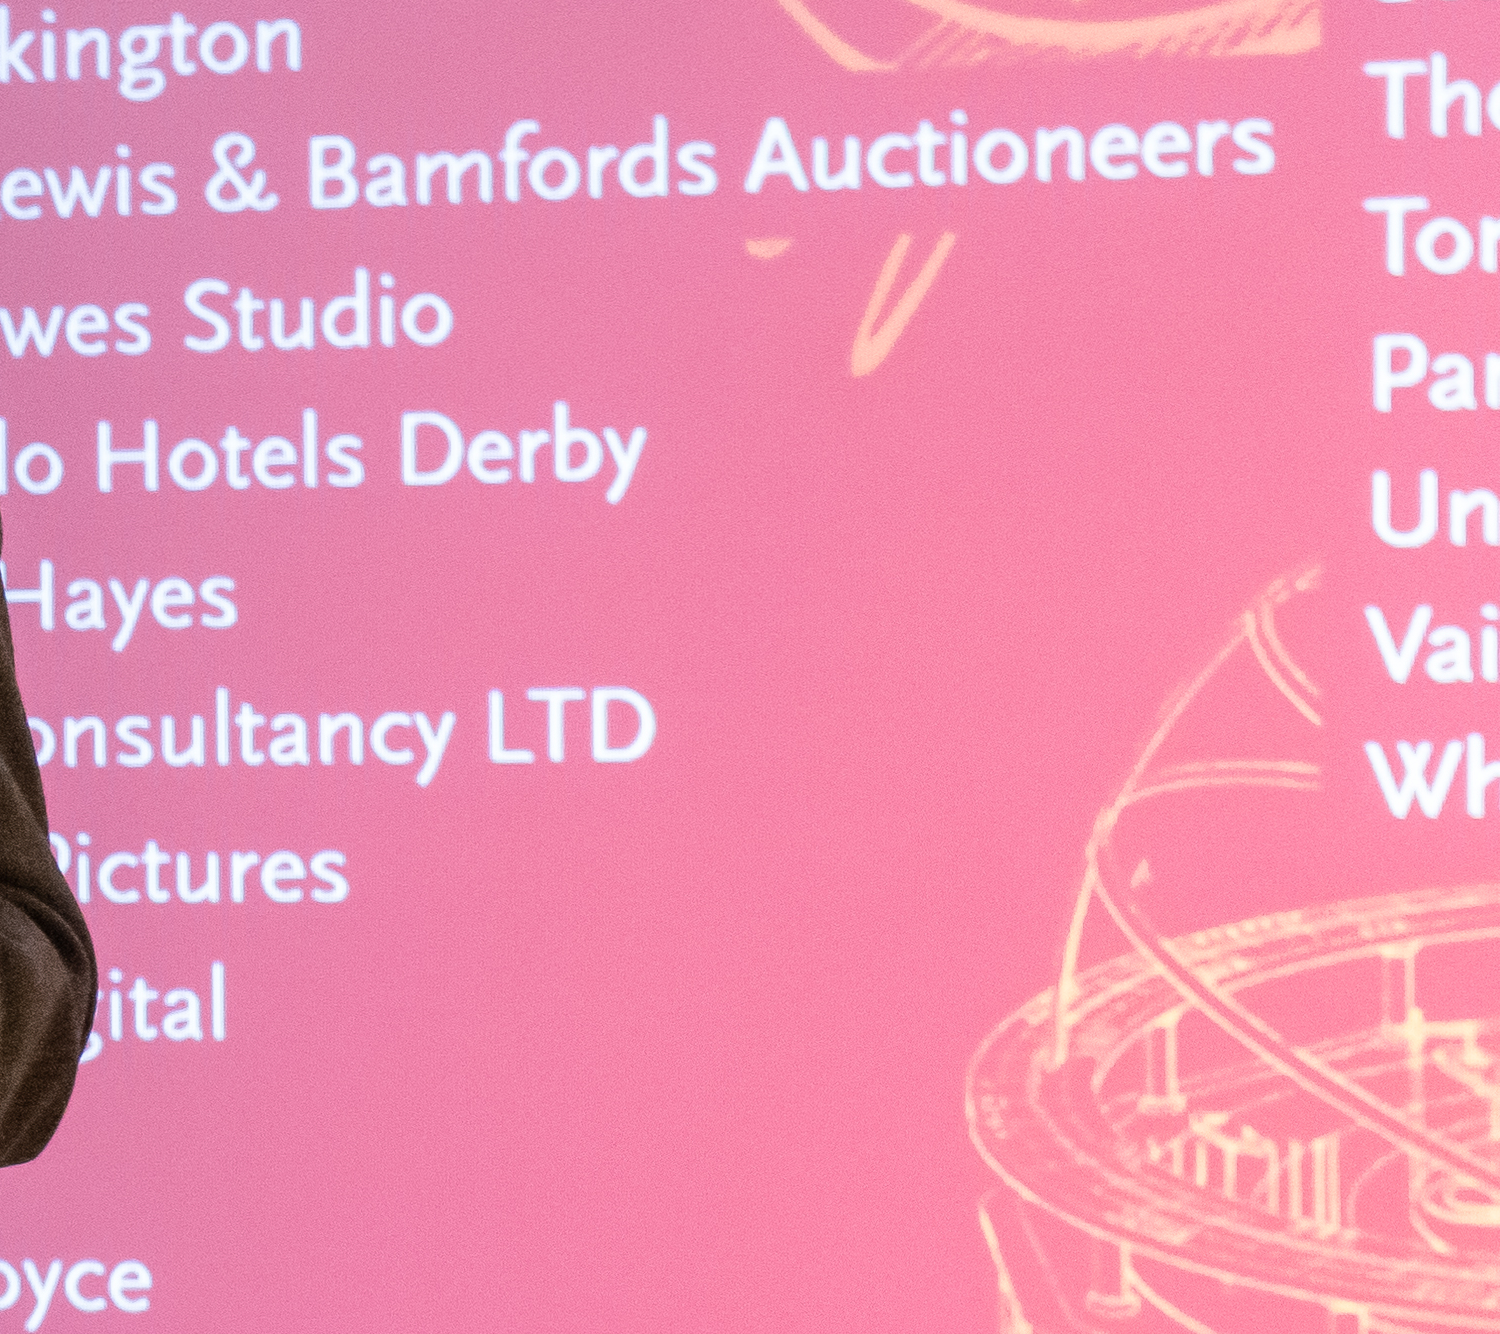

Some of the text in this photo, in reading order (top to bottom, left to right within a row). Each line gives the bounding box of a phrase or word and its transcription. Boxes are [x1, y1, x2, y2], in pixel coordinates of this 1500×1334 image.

[1362, 51, 1500, 139] Th
[204, 131, 279, 214] &
[308, 114, 718, 211] Bamfords
[743, 108, 1276, 194] Auctioneers
[183, 267, 454, 353] Studio
[96, 407, 366, 493] Hotels
[401, 401, 647, 505] Derby
[26, 685, 657, 788] onsultancy LTD
